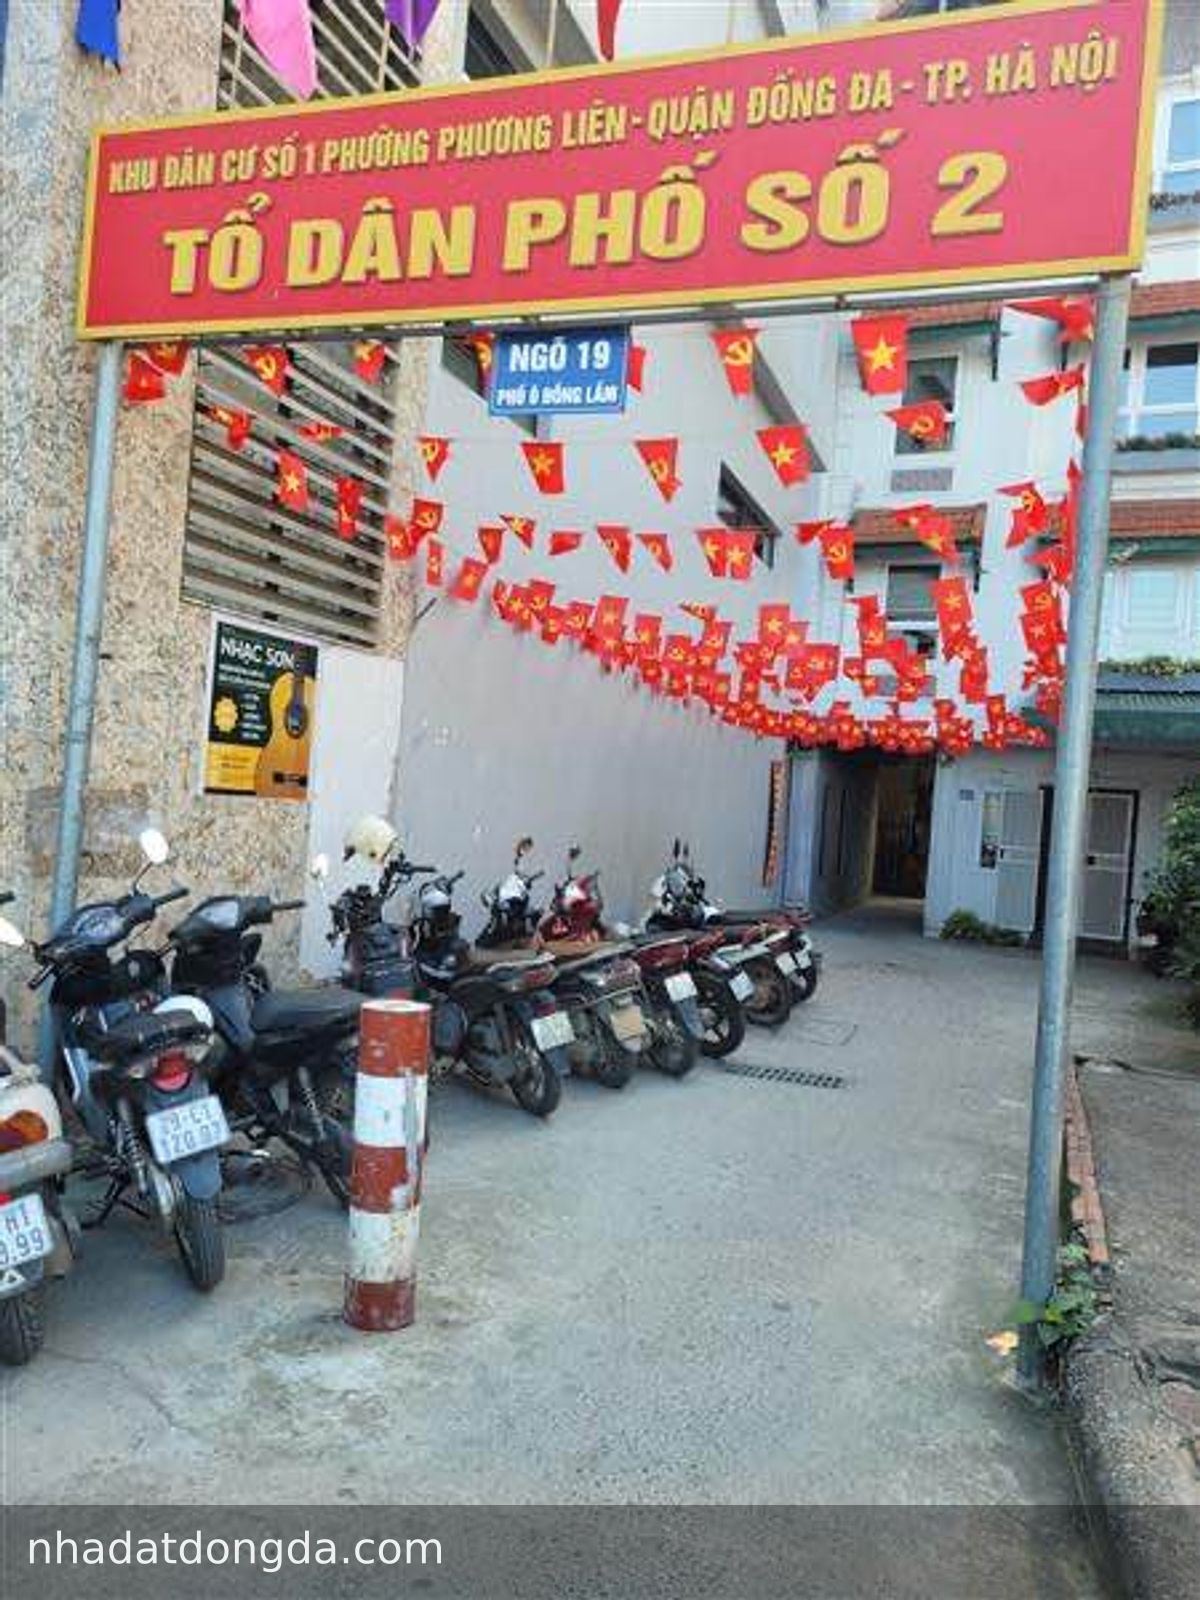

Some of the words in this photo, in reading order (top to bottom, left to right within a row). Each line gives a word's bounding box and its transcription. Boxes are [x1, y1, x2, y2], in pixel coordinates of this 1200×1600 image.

[109, 157, 158, 194] KHU
[163, 146, 216, 190] DÂN
[221, 144, 258, 184] CƯ
[262, 130, 299, 180] SỐ
[303, 141, 317, 175] 1
[320, 124, 430, 174] PHƯỜNG
[437, 114, 553, 162] PHƯƠNG
[561, 98, 628, 149] LIÊN
[649, 86, 735, 141] QUẬN
[747, 66, 837, 128] ĐỒNG
[849, 68, 894, 112] ĐA
[923, 58, 972, 104] TP.
[984, 41, 1037, 94] HÀ
[1050, 30, 1119, 91] NỘI
[163, 192, 272, 295] TỔ
[285, 197, 476, 288] DÂN
[502, 149, 719, 272] PHỐ
[740, 128, 906, 251] SỐ
[931, 152, 1008, 236] 2
[509, 336, 568, 372] NGÕ
[577, 340, 612, 370] 19
